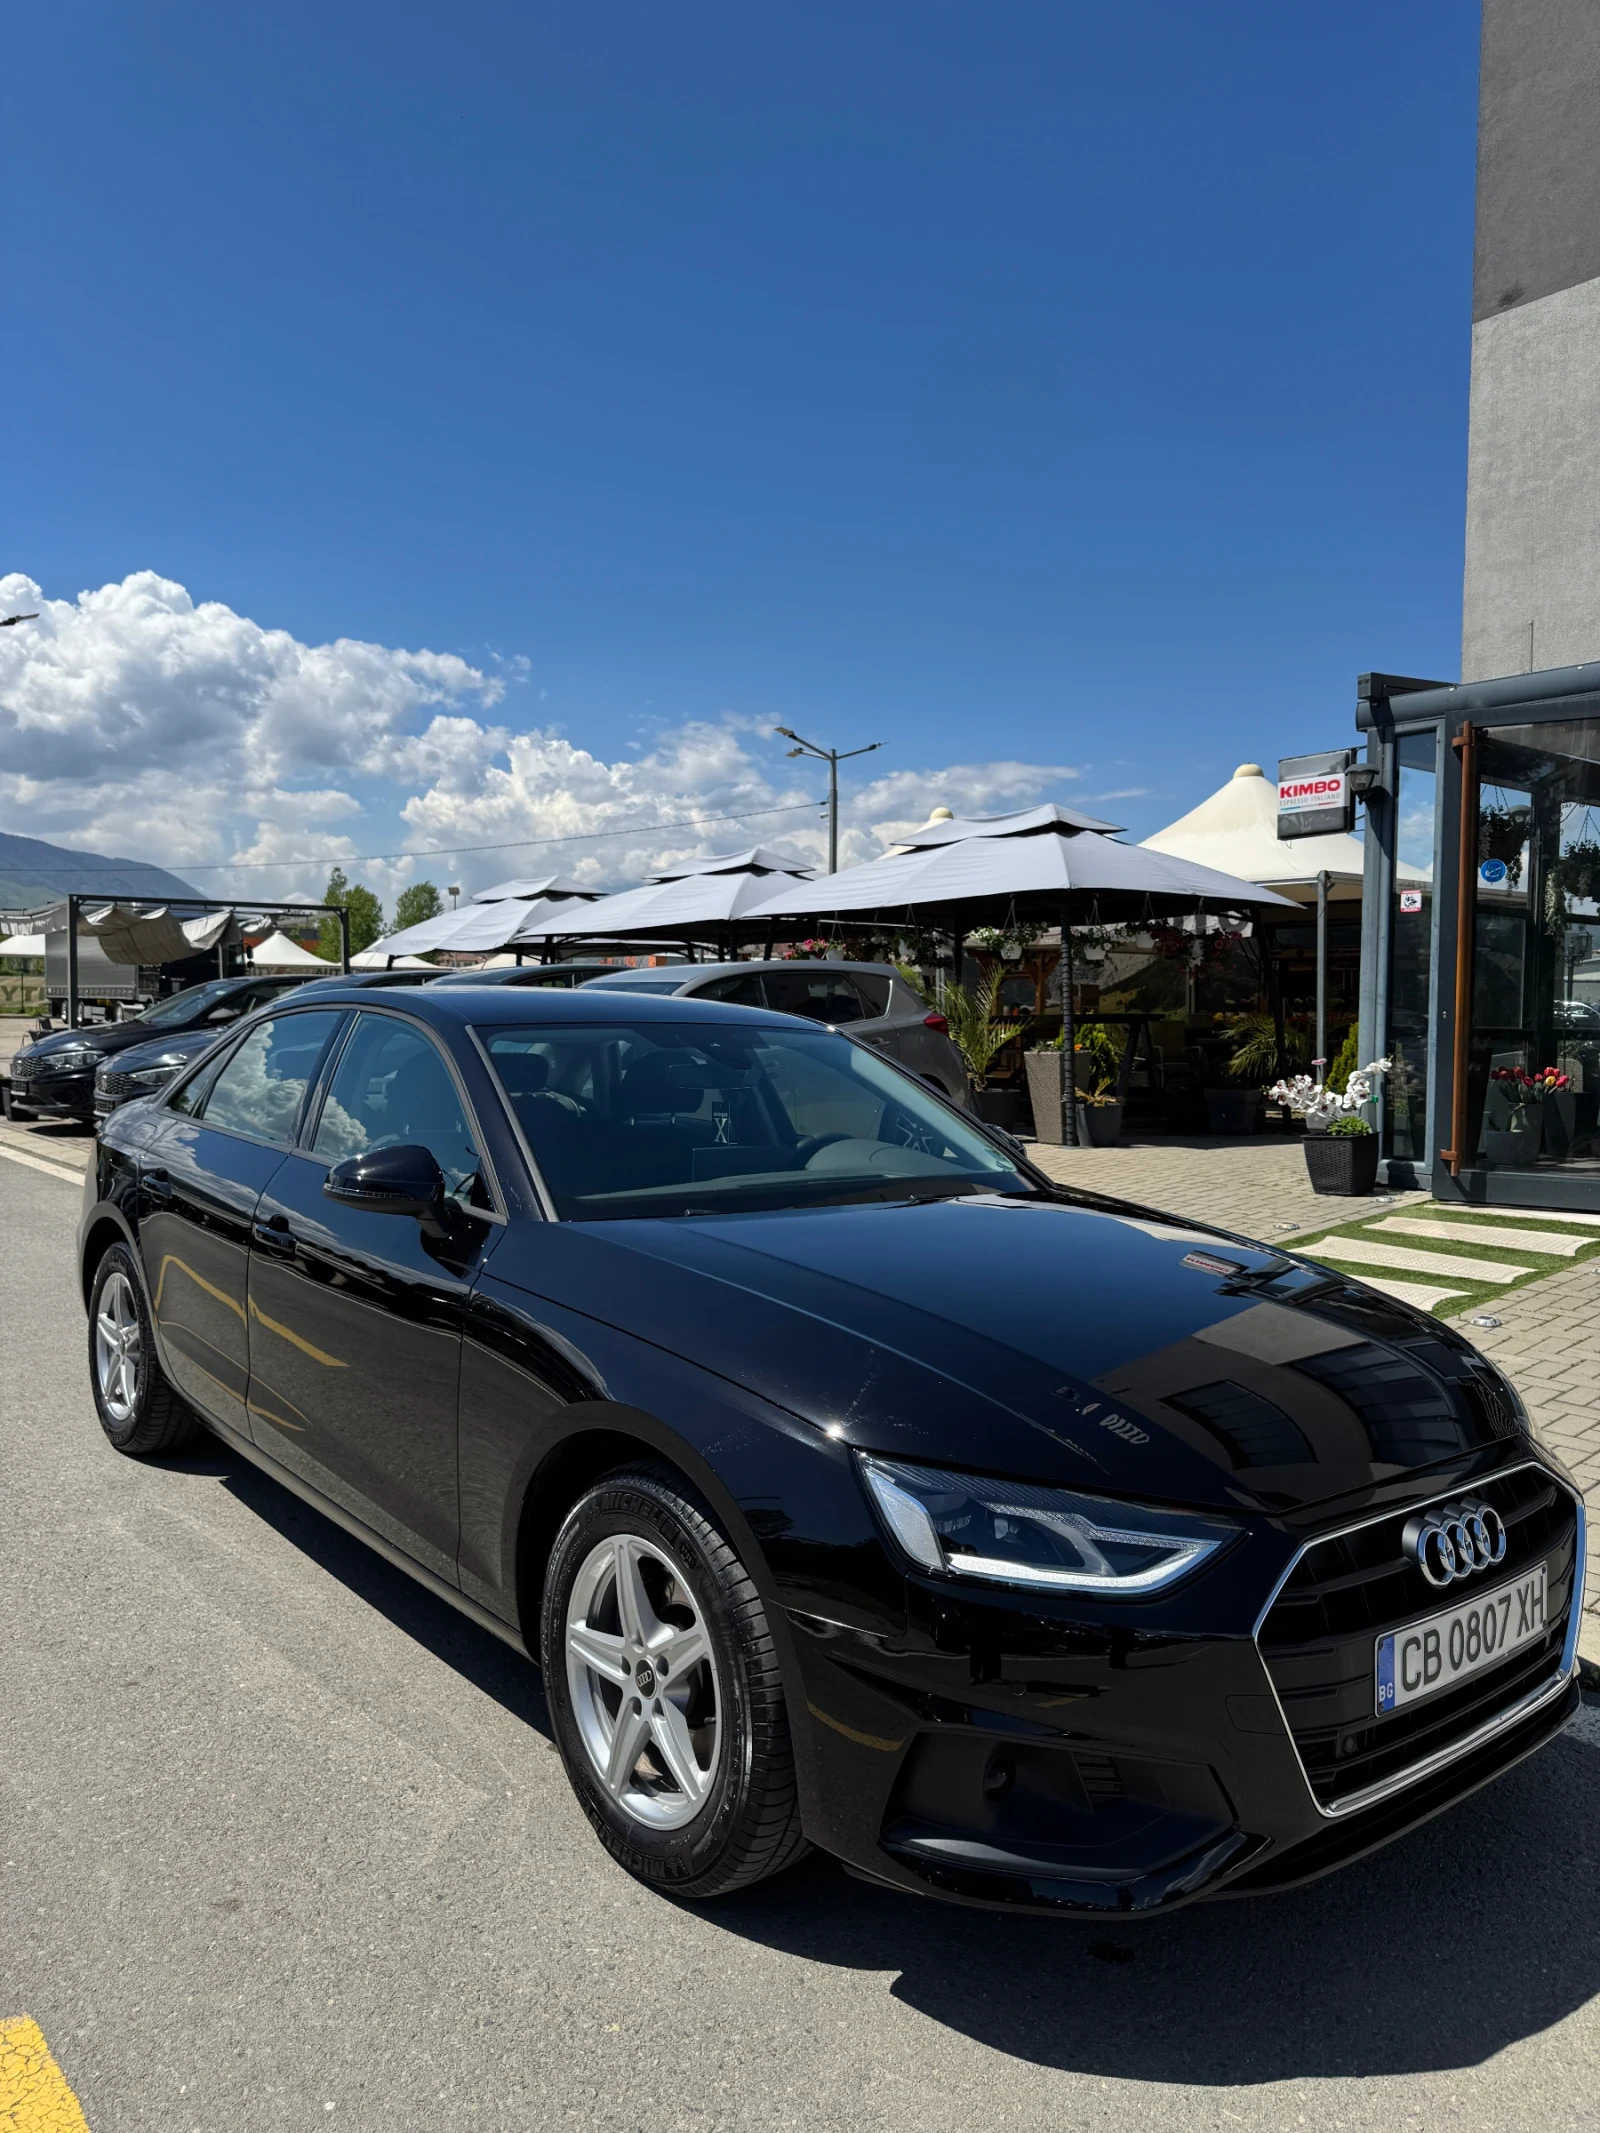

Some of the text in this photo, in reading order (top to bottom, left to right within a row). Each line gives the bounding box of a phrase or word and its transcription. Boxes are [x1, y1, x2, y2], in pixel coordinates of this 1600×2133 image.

[1280, 779, 1341, 799] KIMBO
[1280, 793, 1341, 806] ESPRESSO ITALIANO
[713, 1117, 728, 1144] X
[1402, 1575, 1544, 1692] CB 0807 XH
[1379, 1682, 1394, 1702] BG
